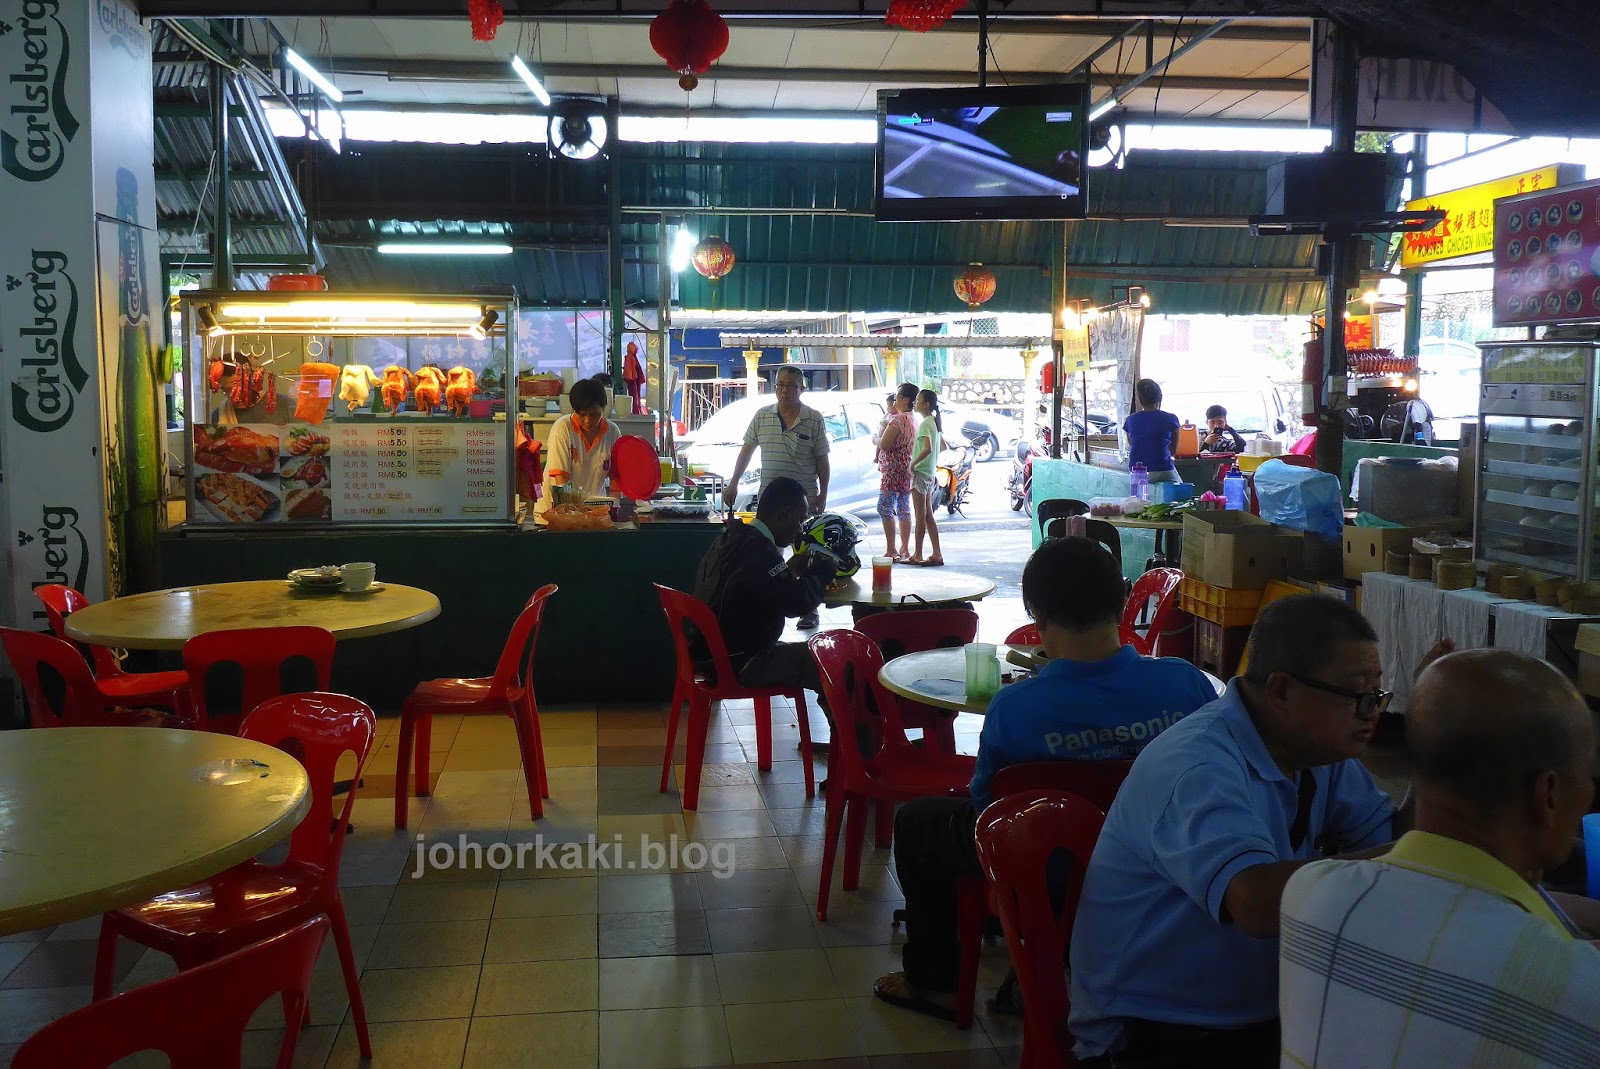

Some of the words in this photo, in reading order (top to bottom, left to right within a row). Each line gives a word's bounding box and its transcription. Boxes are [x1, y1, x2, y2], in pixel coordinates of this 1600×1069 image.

[1, 0, 65, 181] Carlsberg
[125, 213, 143, 320] Carlsberg
[1446, 235, 1474, 254] CHICKEN
[1476, 230, 1494, 249] WING
[12, 249, 75, 433] Carlsberg
[1044, 709, 1185, 755] Panasonic
